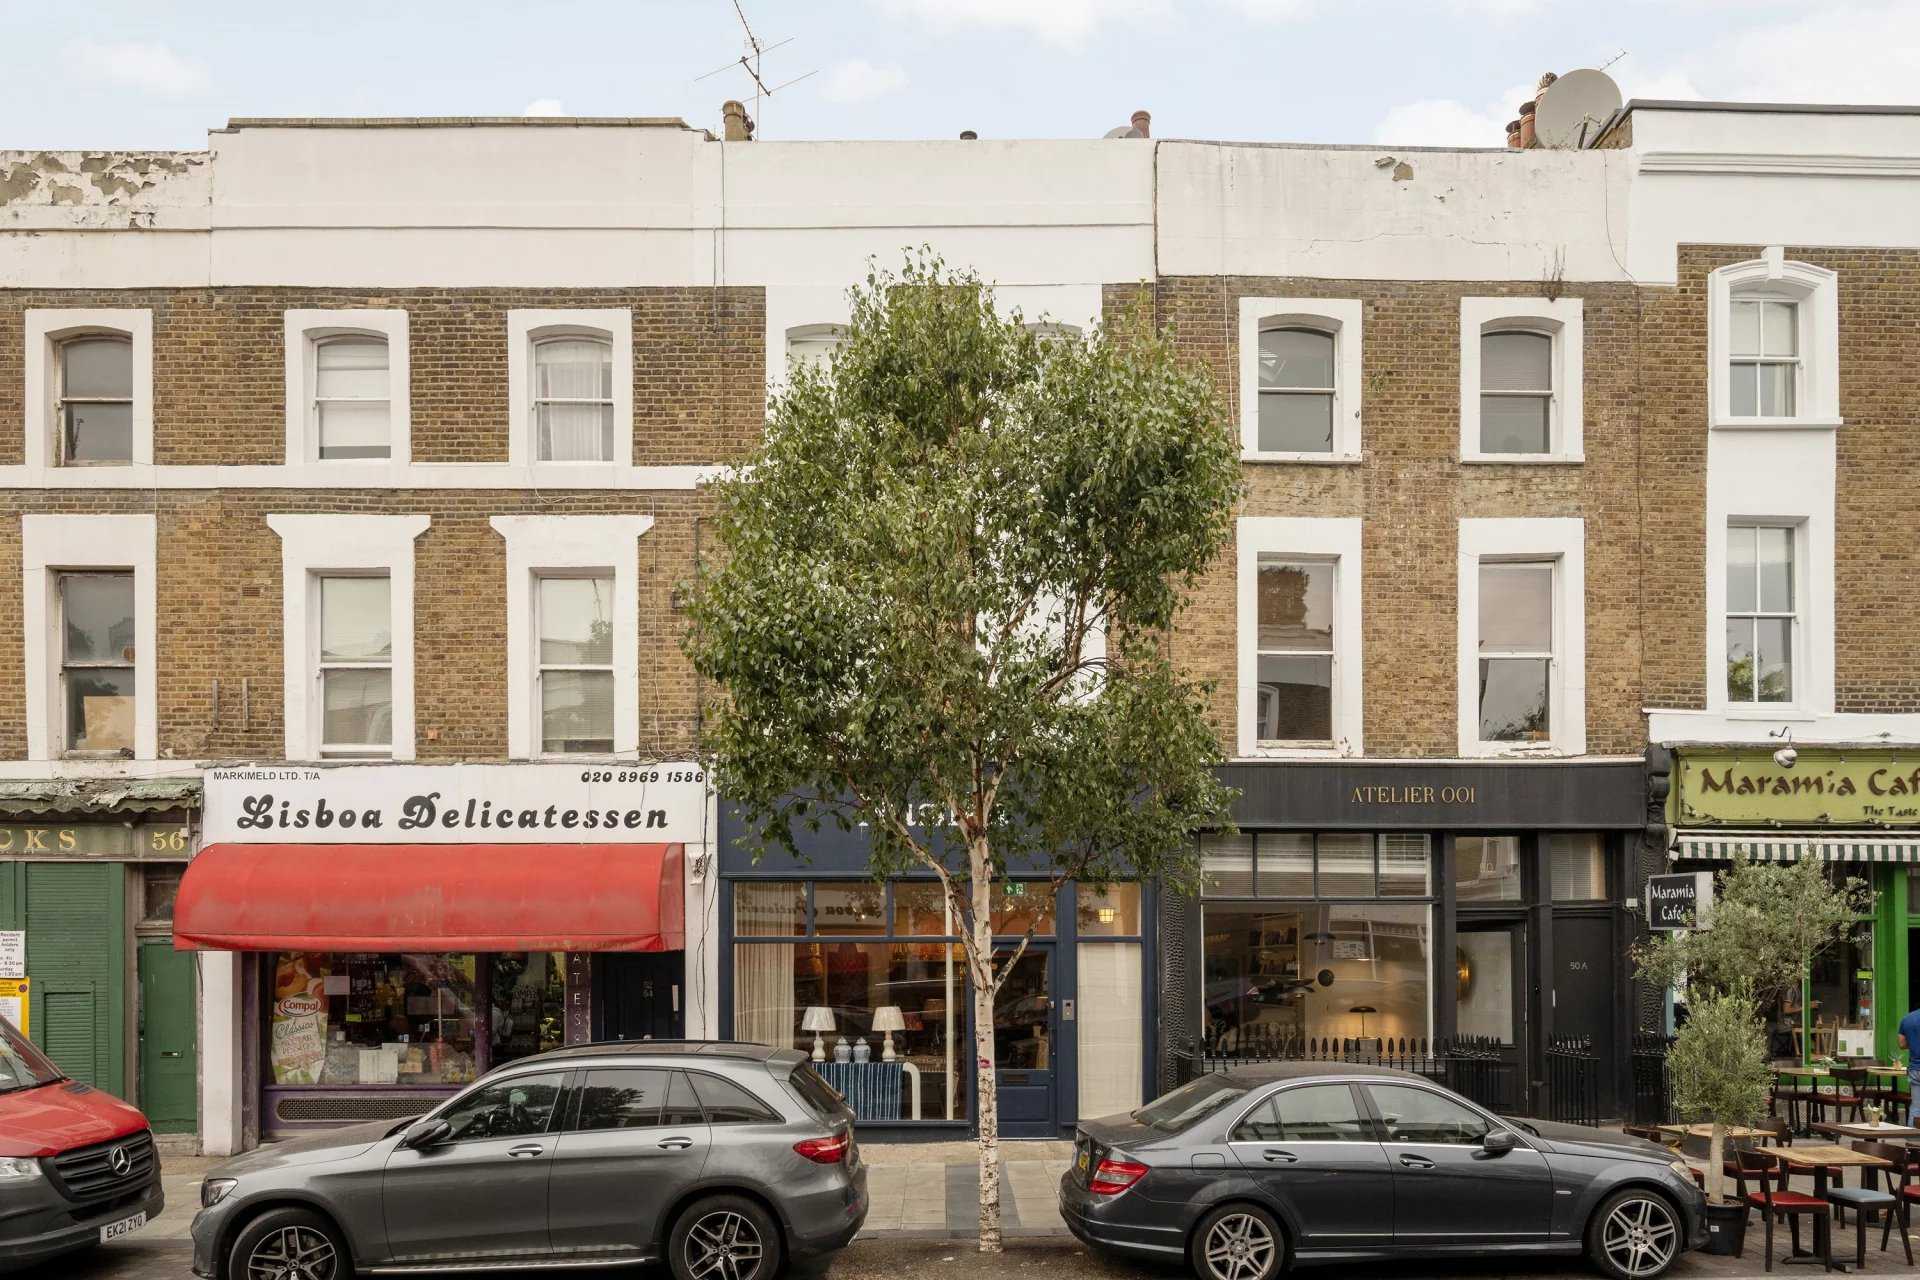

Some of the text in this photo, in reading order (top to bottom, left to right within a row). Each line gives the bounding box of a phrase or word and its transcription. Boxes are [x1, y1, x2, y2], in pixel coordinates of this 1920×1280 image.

[213, 771, 276, 781] MARKIMELD
[303, 771, 320, 781] T/A
[581, 771, 704, 783] 020 8969 1586
[1701, 767, 1857, 796] Maramia
[1351, 786, 1435, 803] ATELIER
[236, 791, 669, 829] Lisboa Delicatessen
[1862, 805, 1918, 817] The Taste
[152, 831, 185, 851] 56
[1651, 884, 1695, 899] Maramia
[283, 999, 319, 1012] Compal
